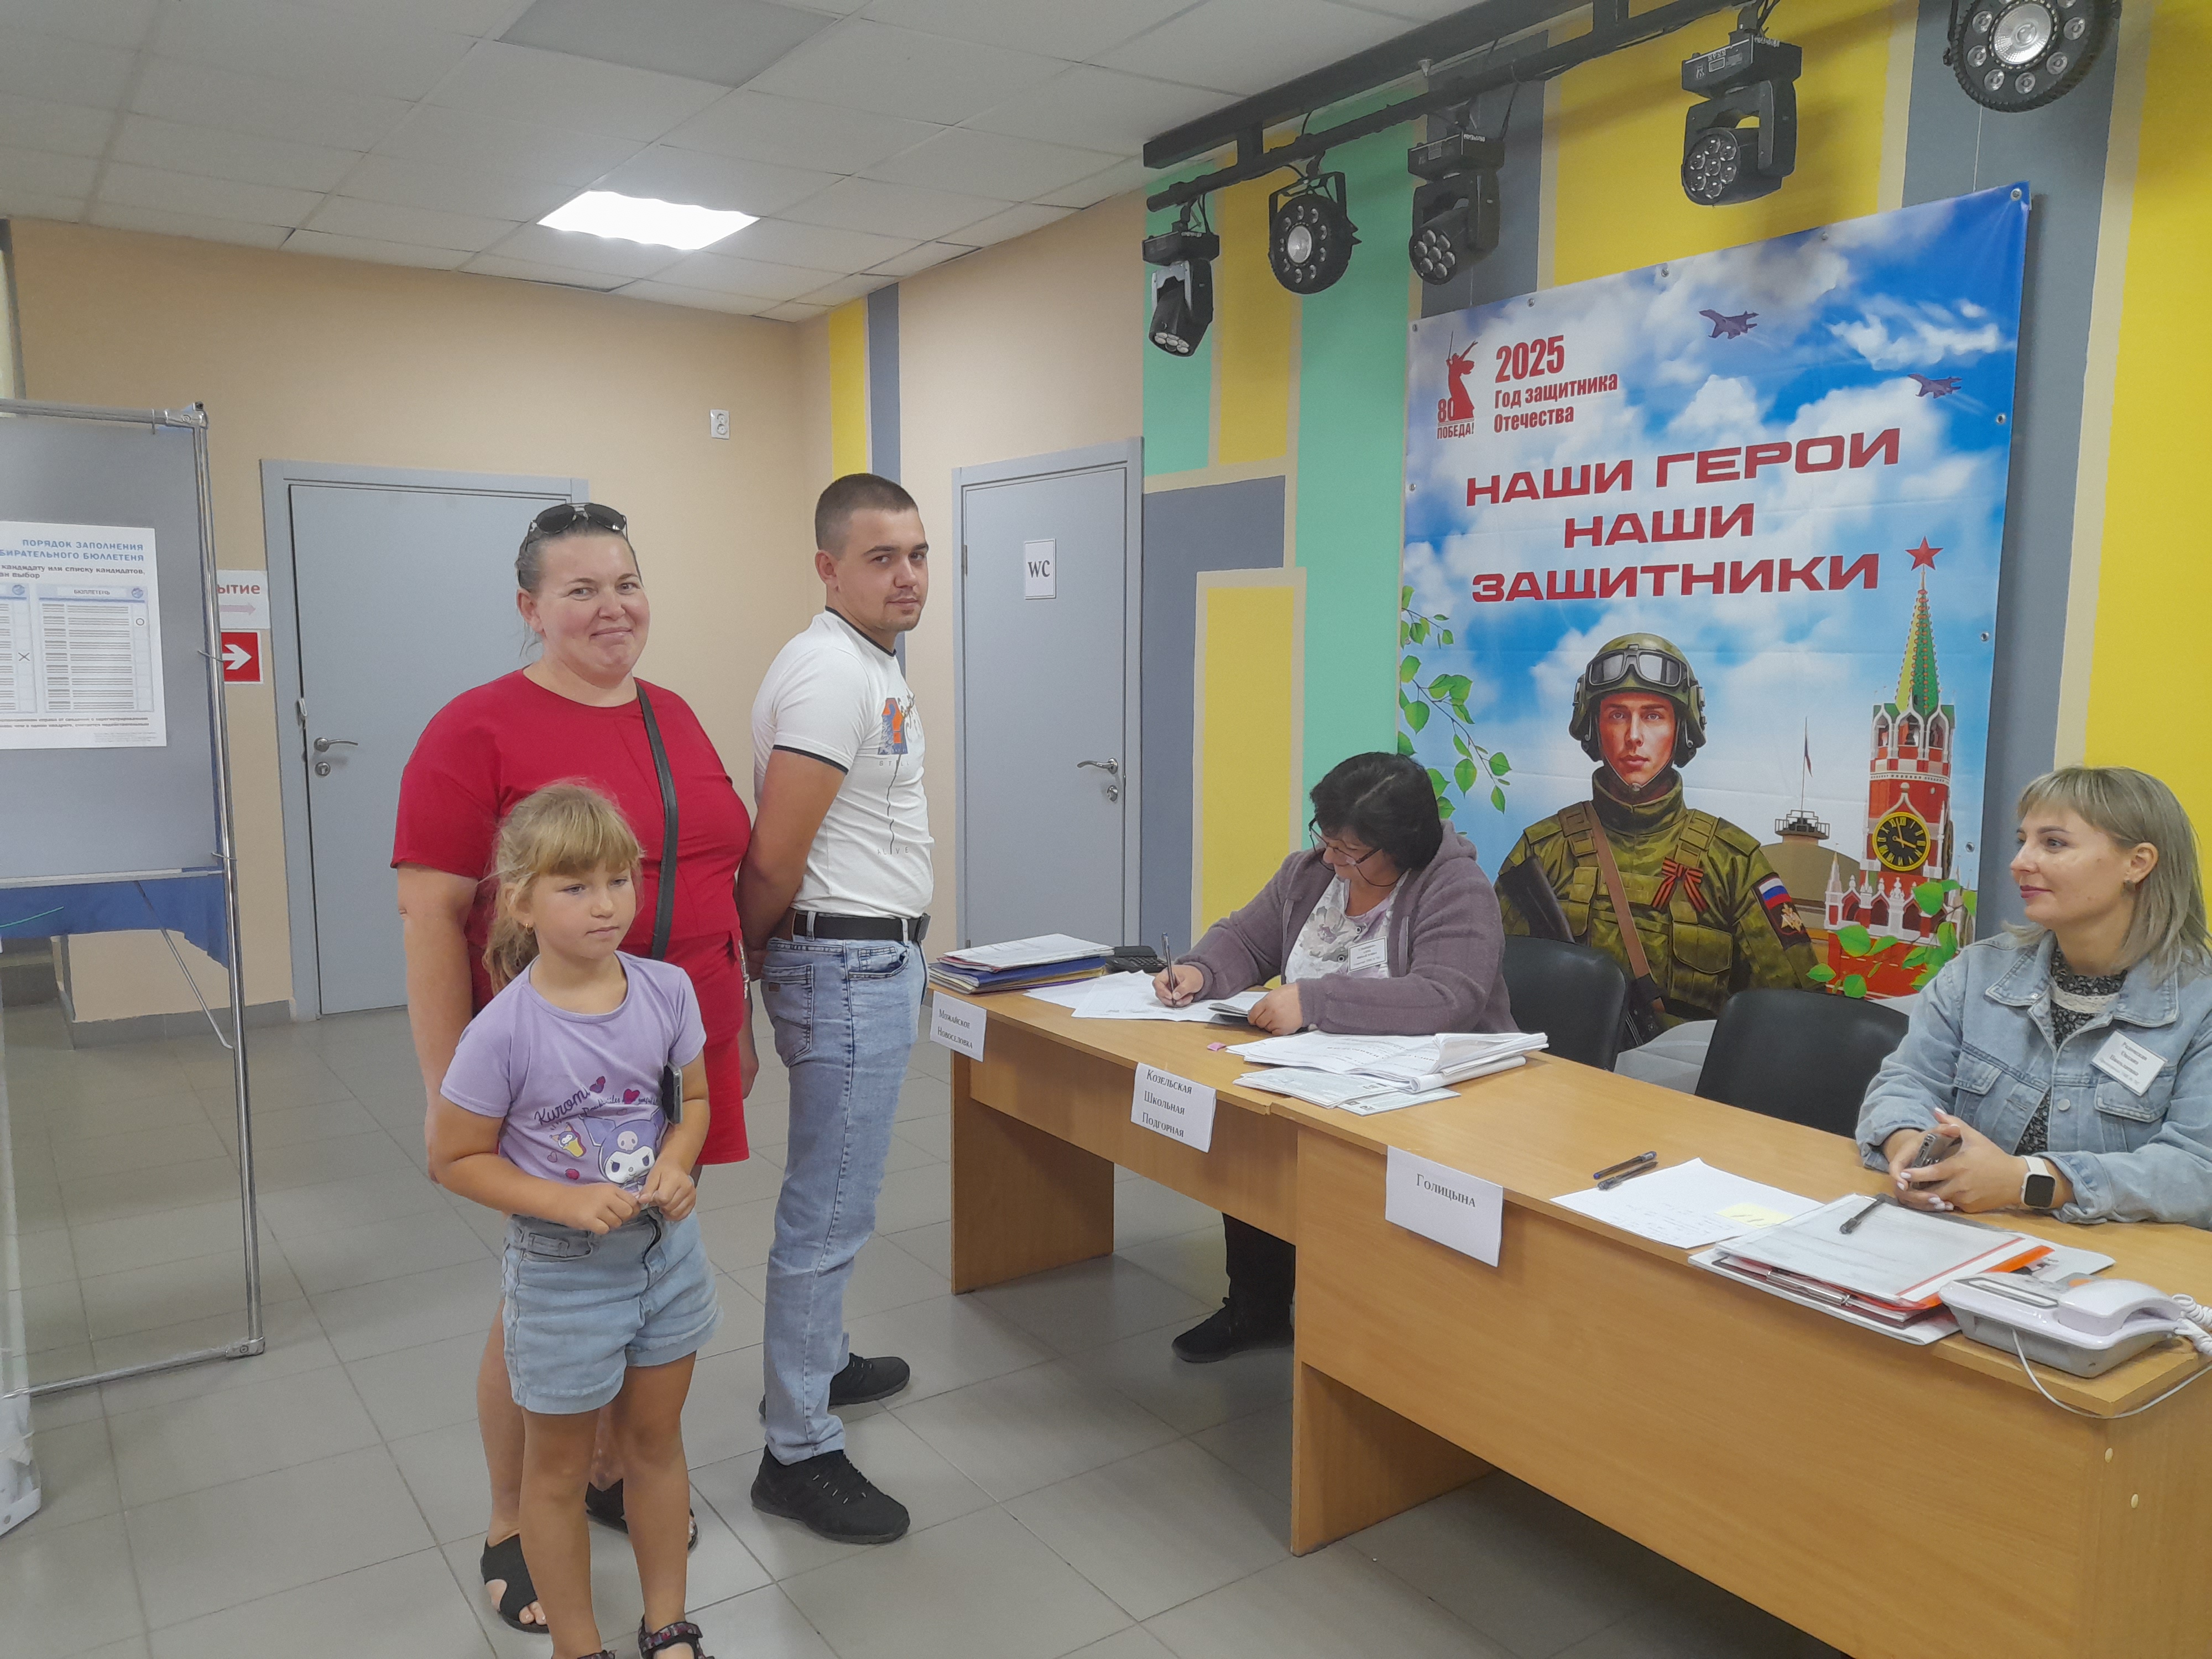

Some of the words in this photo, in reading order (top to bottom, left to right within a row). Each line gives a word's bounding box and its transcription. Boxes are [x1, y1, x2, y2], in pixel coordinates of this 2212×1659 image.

[1495, 335, 1564, 384] 2025
[1494, 389, 1521, 410] Год
[1525, 373, 1618, 404] защитника
[1437, 422, 1475, 440] ПОБЕДА!
[1494, 406, 1574, 434] Отечества
[1466, 458, 1633, 507] НАШИ
[1656, 427, 1901, 488] ГЕРОИ
[1564, 503, 1755, 549] НАШИ
[23, 539, 72, 548] ПОРЯДОК
[76, 541, 144, 551] ЗАПОЛНЕНИЯ
[83, 552, 144, 562] БЮЛЛЕТЕНЯ
[12, 572, 40, 580] выбор
[1027, 560, 1050, 578] WC
[1472, 553, 1880, 603] ЗАЩИТНИКИ
